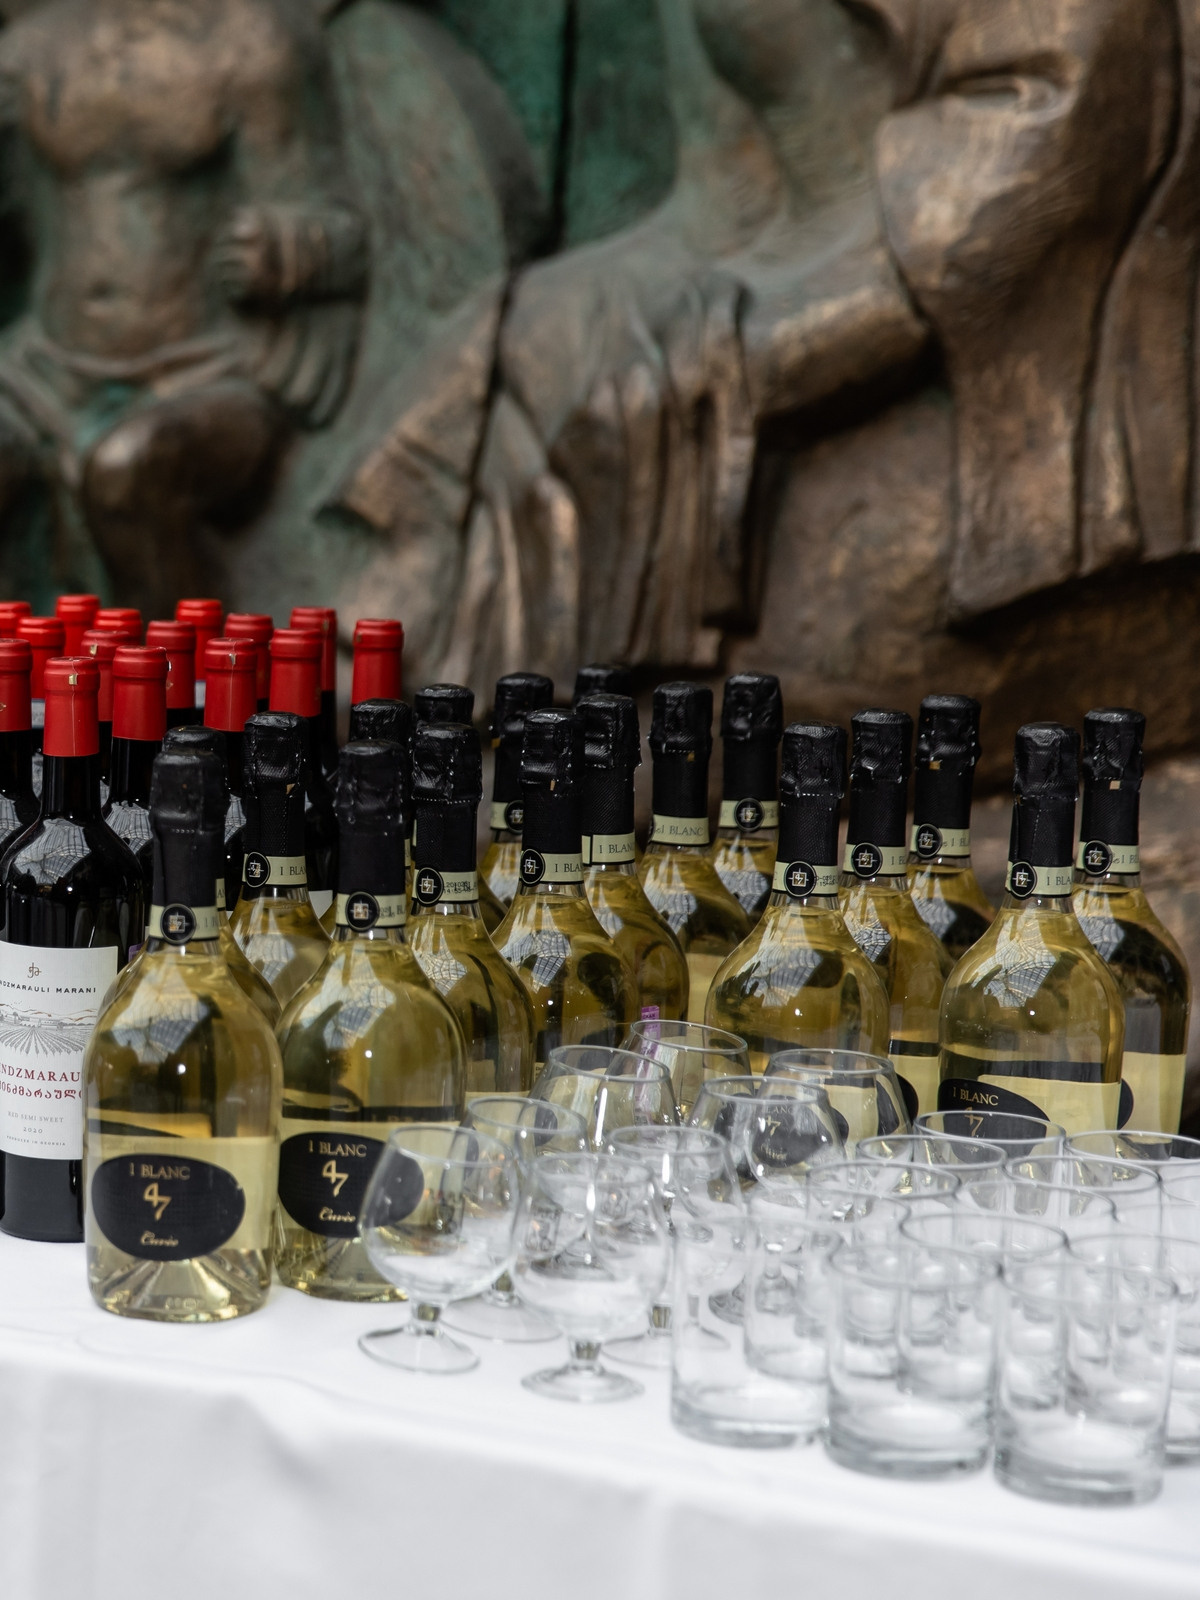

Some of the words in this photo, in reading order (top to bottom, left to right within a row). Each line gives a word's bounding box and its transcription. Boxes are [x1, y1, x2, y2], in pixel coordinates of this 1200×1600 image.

[669, 825, 704, 837] BLANC
[960, 1088, 999, 1107] BLANC
[20, 1113, 37, 1121] SEMI
[23, 1126, 43, 1134] 2020
[319, 1141, 367, 1158] BLANC
[140, 1164, 190, 1180] BLANC
